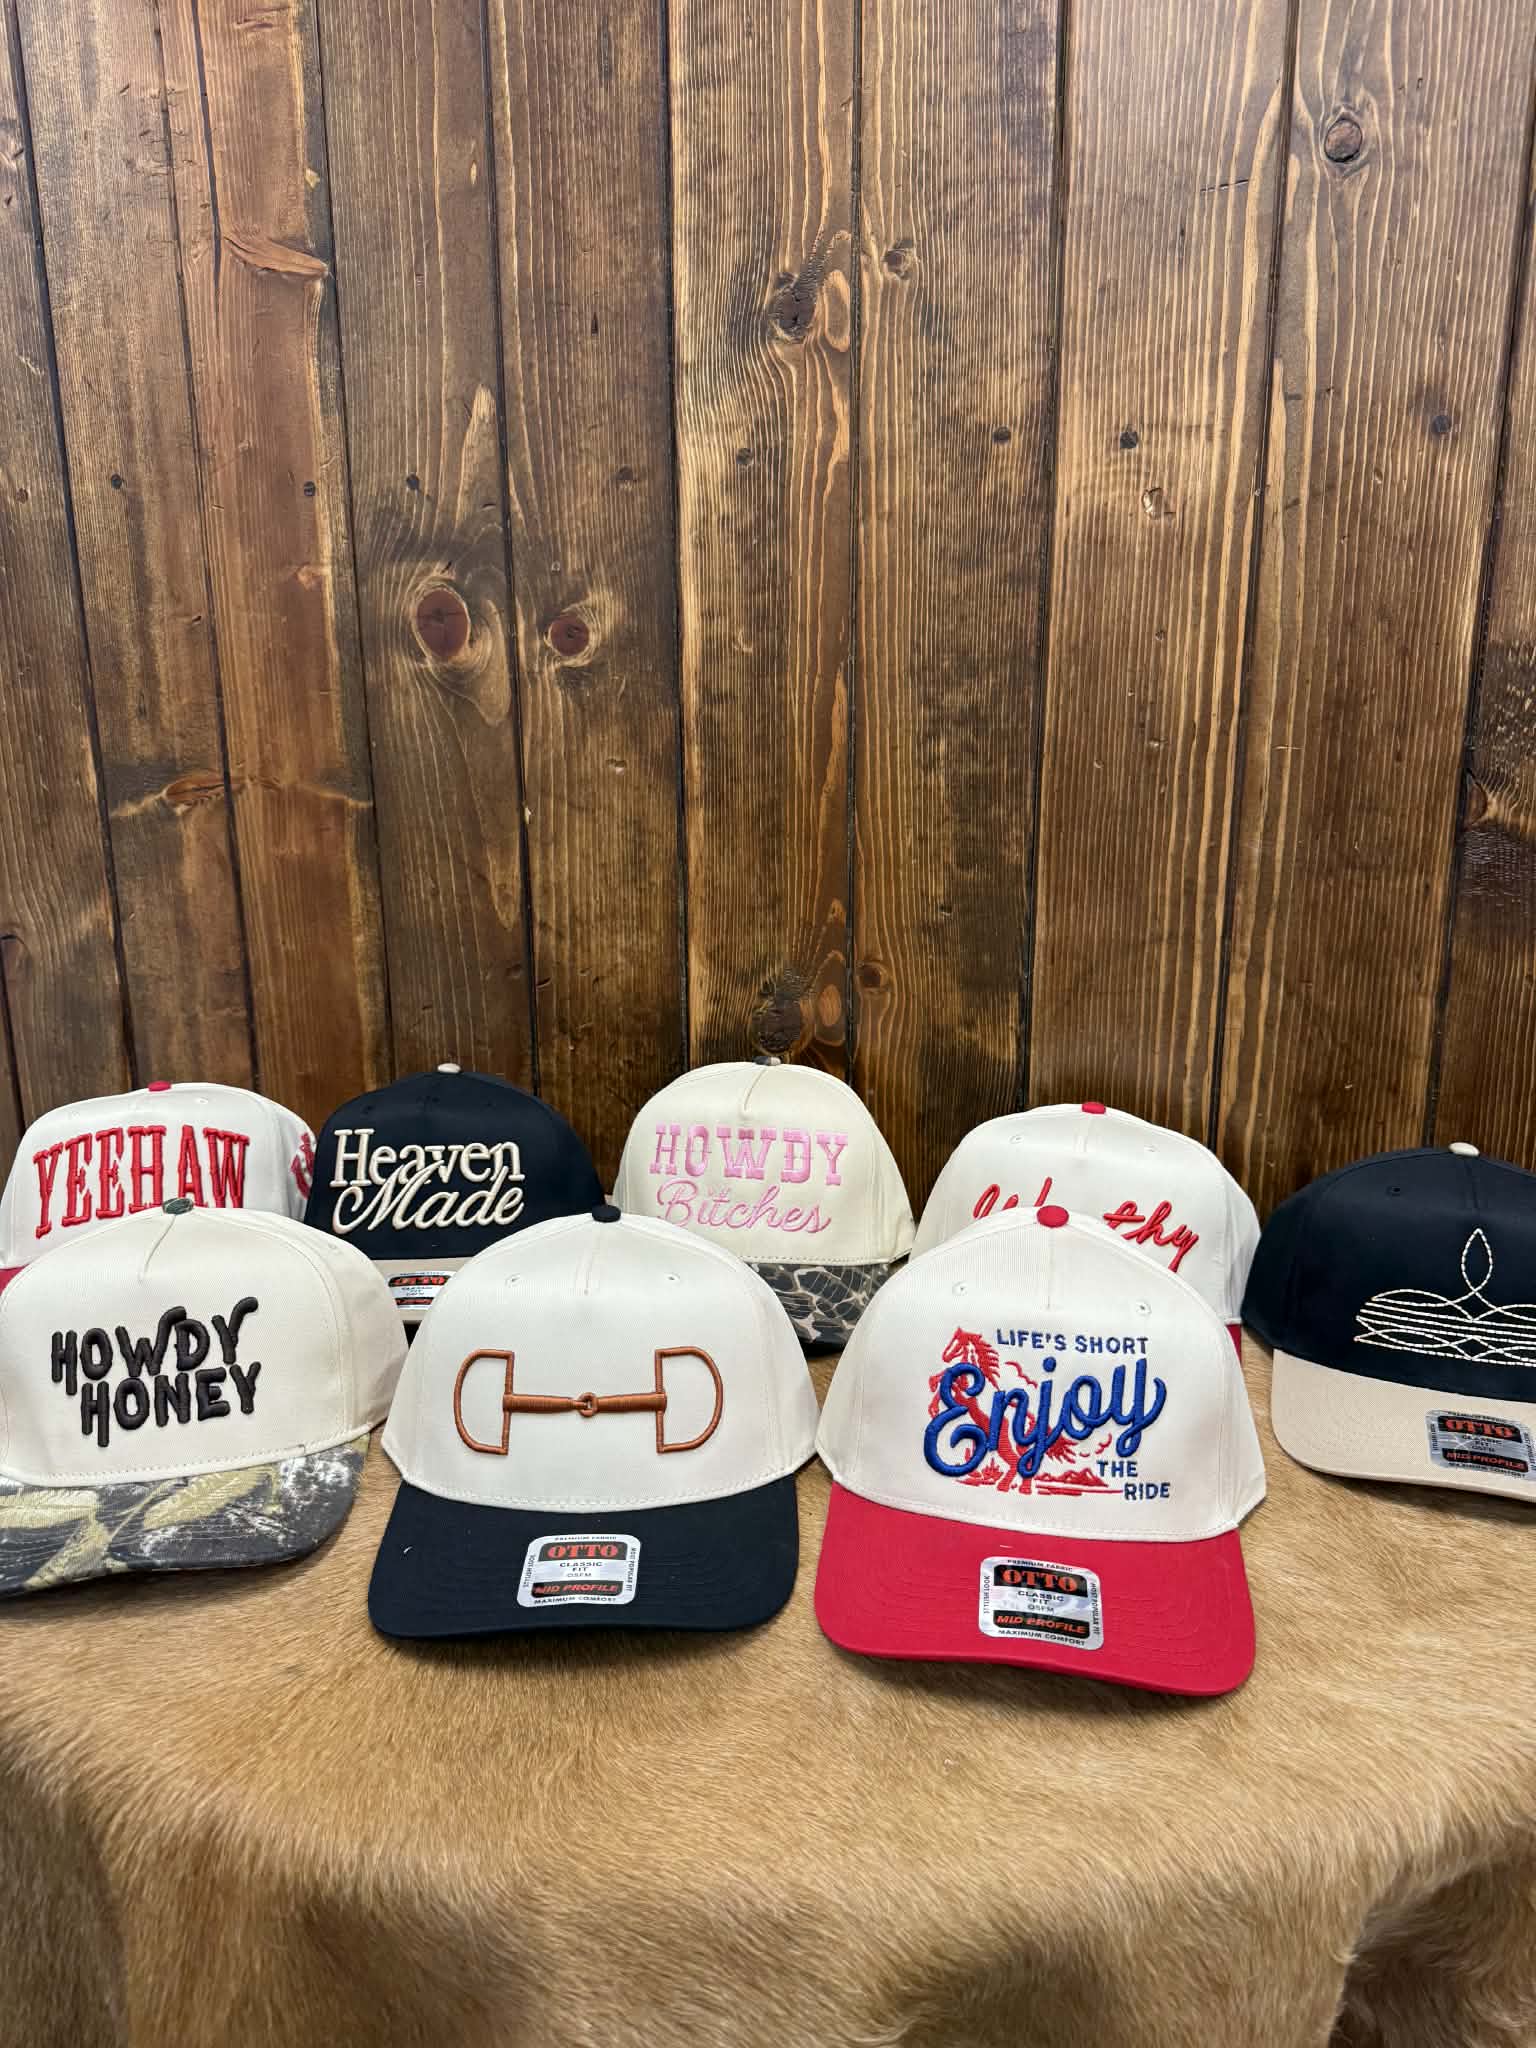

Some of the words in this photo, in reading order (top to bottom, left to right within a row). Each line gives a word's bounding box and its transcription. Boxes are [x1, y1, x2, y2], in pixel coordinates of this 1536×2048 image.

[330, 1128, 525, 1187] Heaven
[650, 1124, 848, 1186] HOWDY
[33, 1125, 250, 1239] YEEHAW
[332, 1160, 524, 1235] Made
[657, 1180, 832, 1233] Bitches
[51, 1296, 259, 1395] HOWDY
[996, 1329, 1067, 1351] LIFE'S
[1075, 1335, 1148, 1355] SHORT
[80, 1361, 261, 1447] HONEY
[924, 1357, 1167, 1478] Enjoy
[1097, 1460, 1138, 1477] THE
[1124, 1483, 1171, 1500] RIDE
[547, 1545, 619, 1559] OTTO
[534, 1585, 561, 1594] MID
[562, 1583, 619, 1593] PROFILE
[1002, 1569, 1078, 1592] OTTO
[534, 1596, 576, 1605] MAXIMUM
[1018, 1590, 1065, 1602] CLASSIC
[996, 1615, 1023, 1625] MID
[1026, 1616, 1087, 1634] PROFILE
[998, 1629, 1042, 1639] MAXIMUM
[1044, 1633, 1086, 1646] COMFORT
